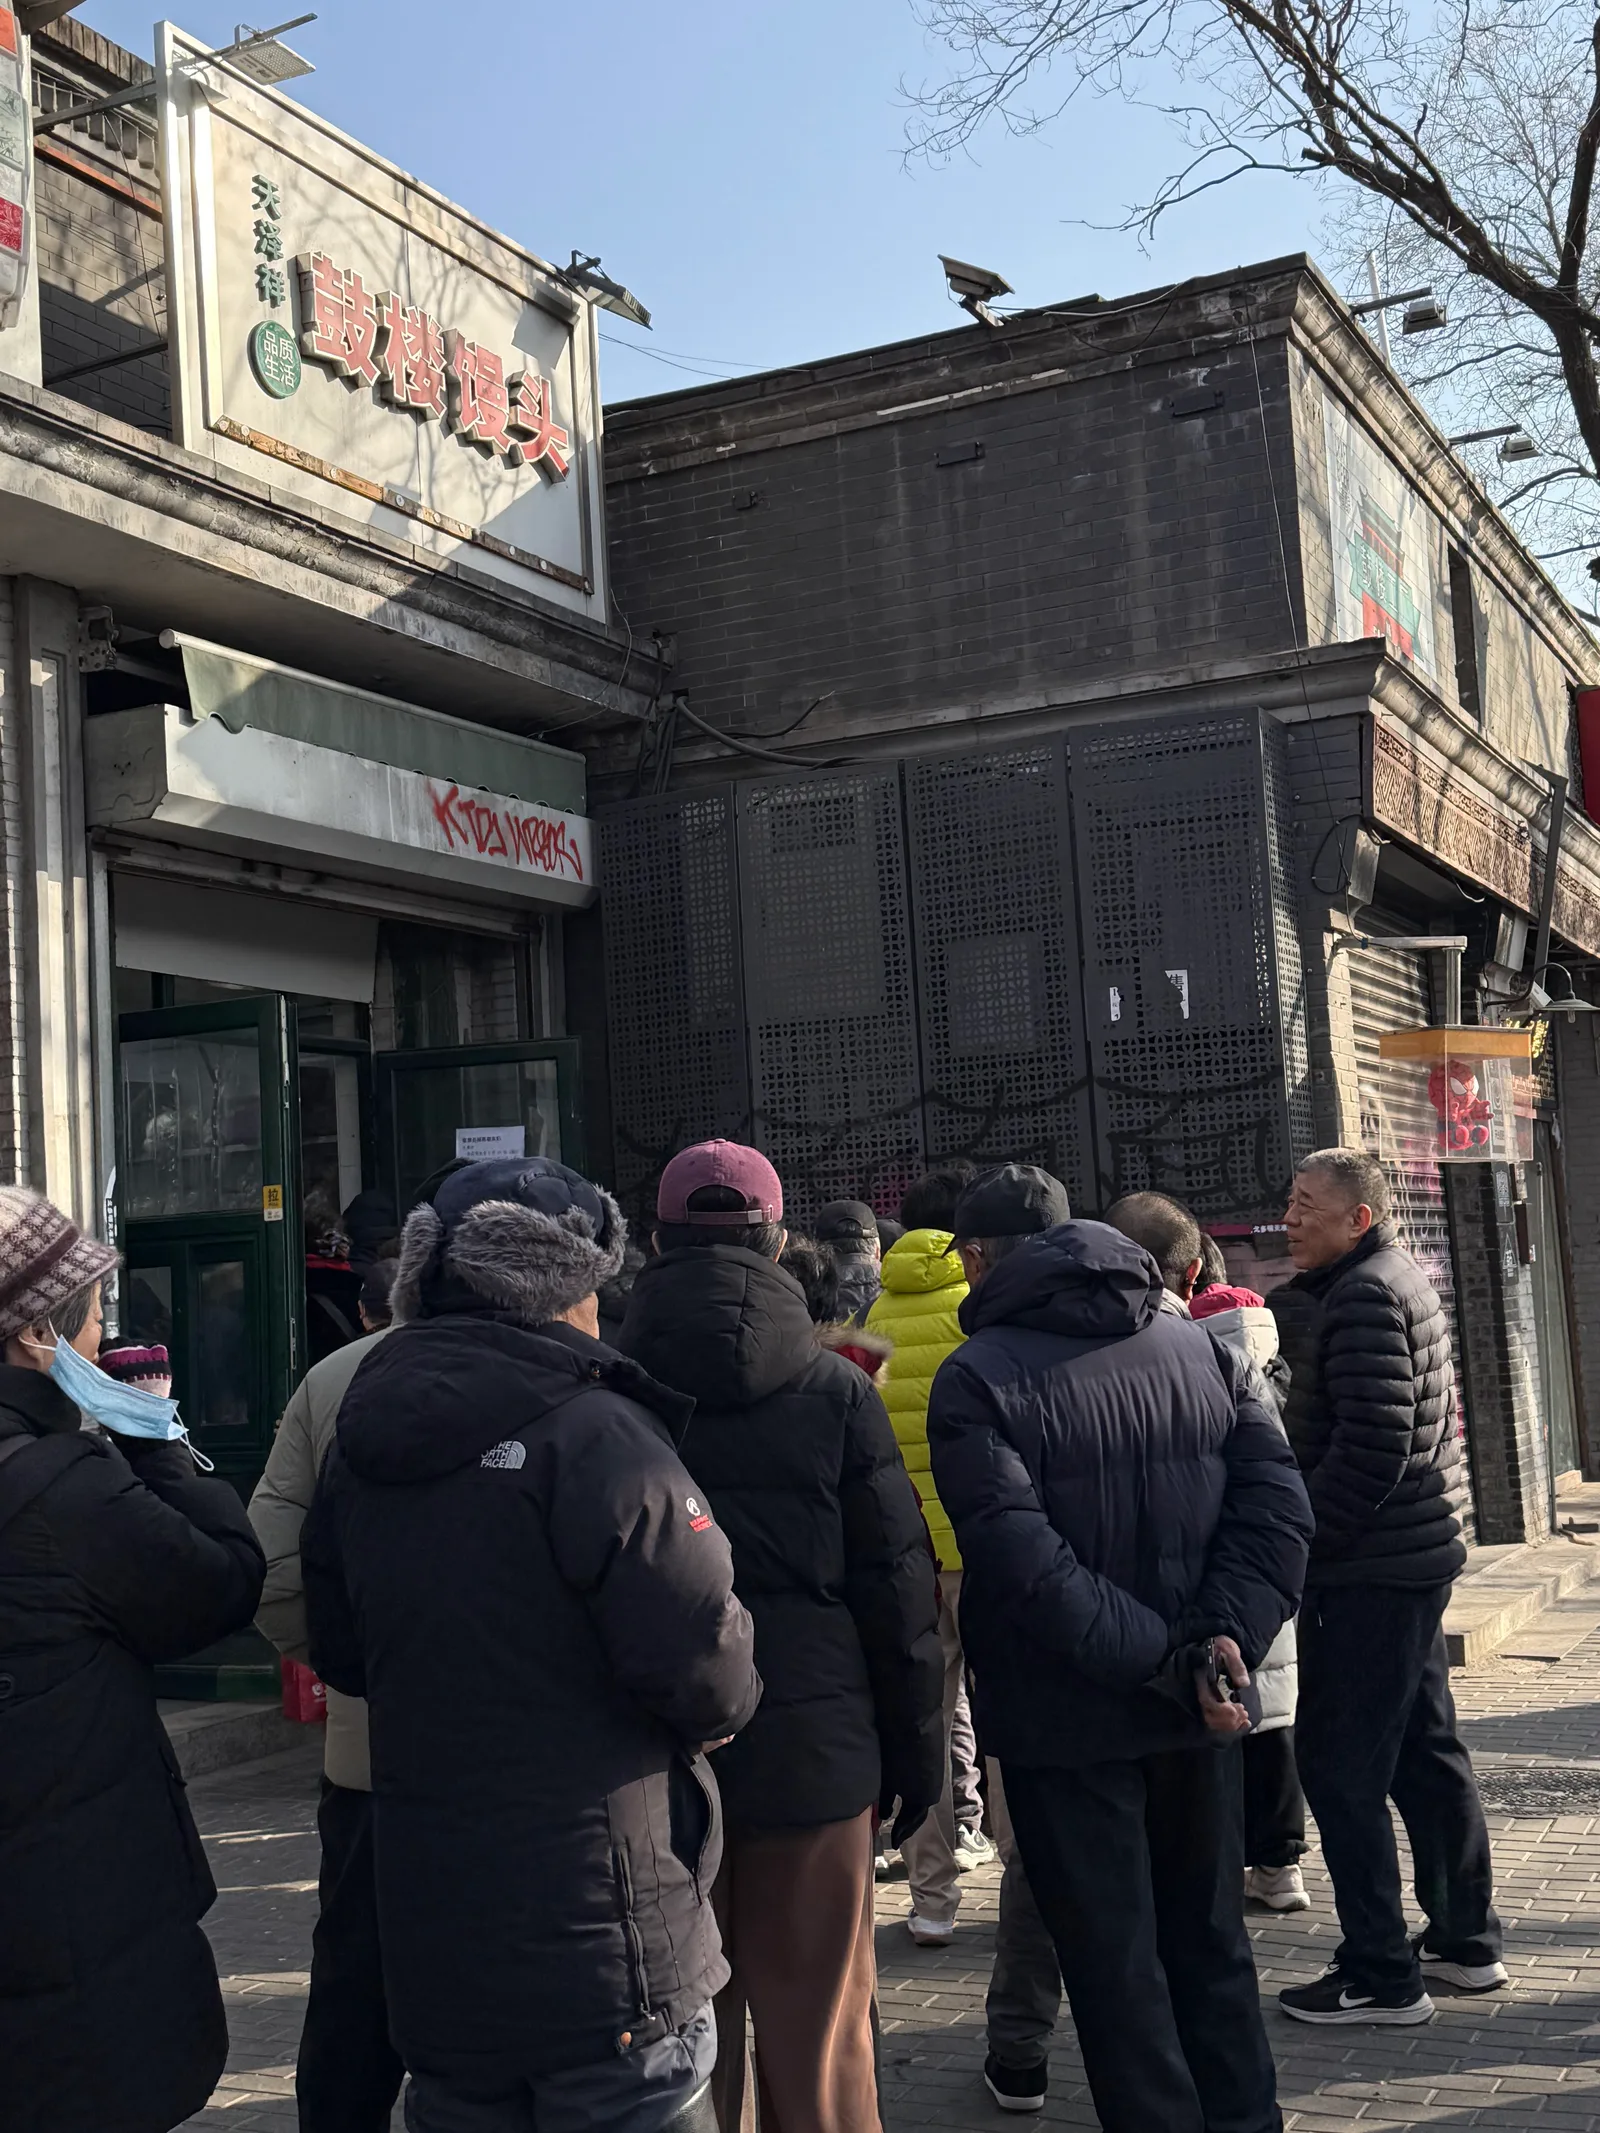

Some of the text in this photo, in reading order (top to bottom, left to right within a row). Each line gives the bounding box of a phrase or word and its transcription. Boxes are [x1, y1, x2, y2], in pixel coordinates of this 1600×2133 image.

[252, 174, 285, 308] 天泽祥
[264, 330, 294, 363] 品质
[264, 355, 295, 388] 生活
[298, 251, 569, 484] 鼓楼馒头
[267, 1188, 279, 1202] 拉
[481, 1449, 510, 1458] RTH
[493, 1440, 513, 1450] HE
[480, 1458, 507, 1468] FACE
